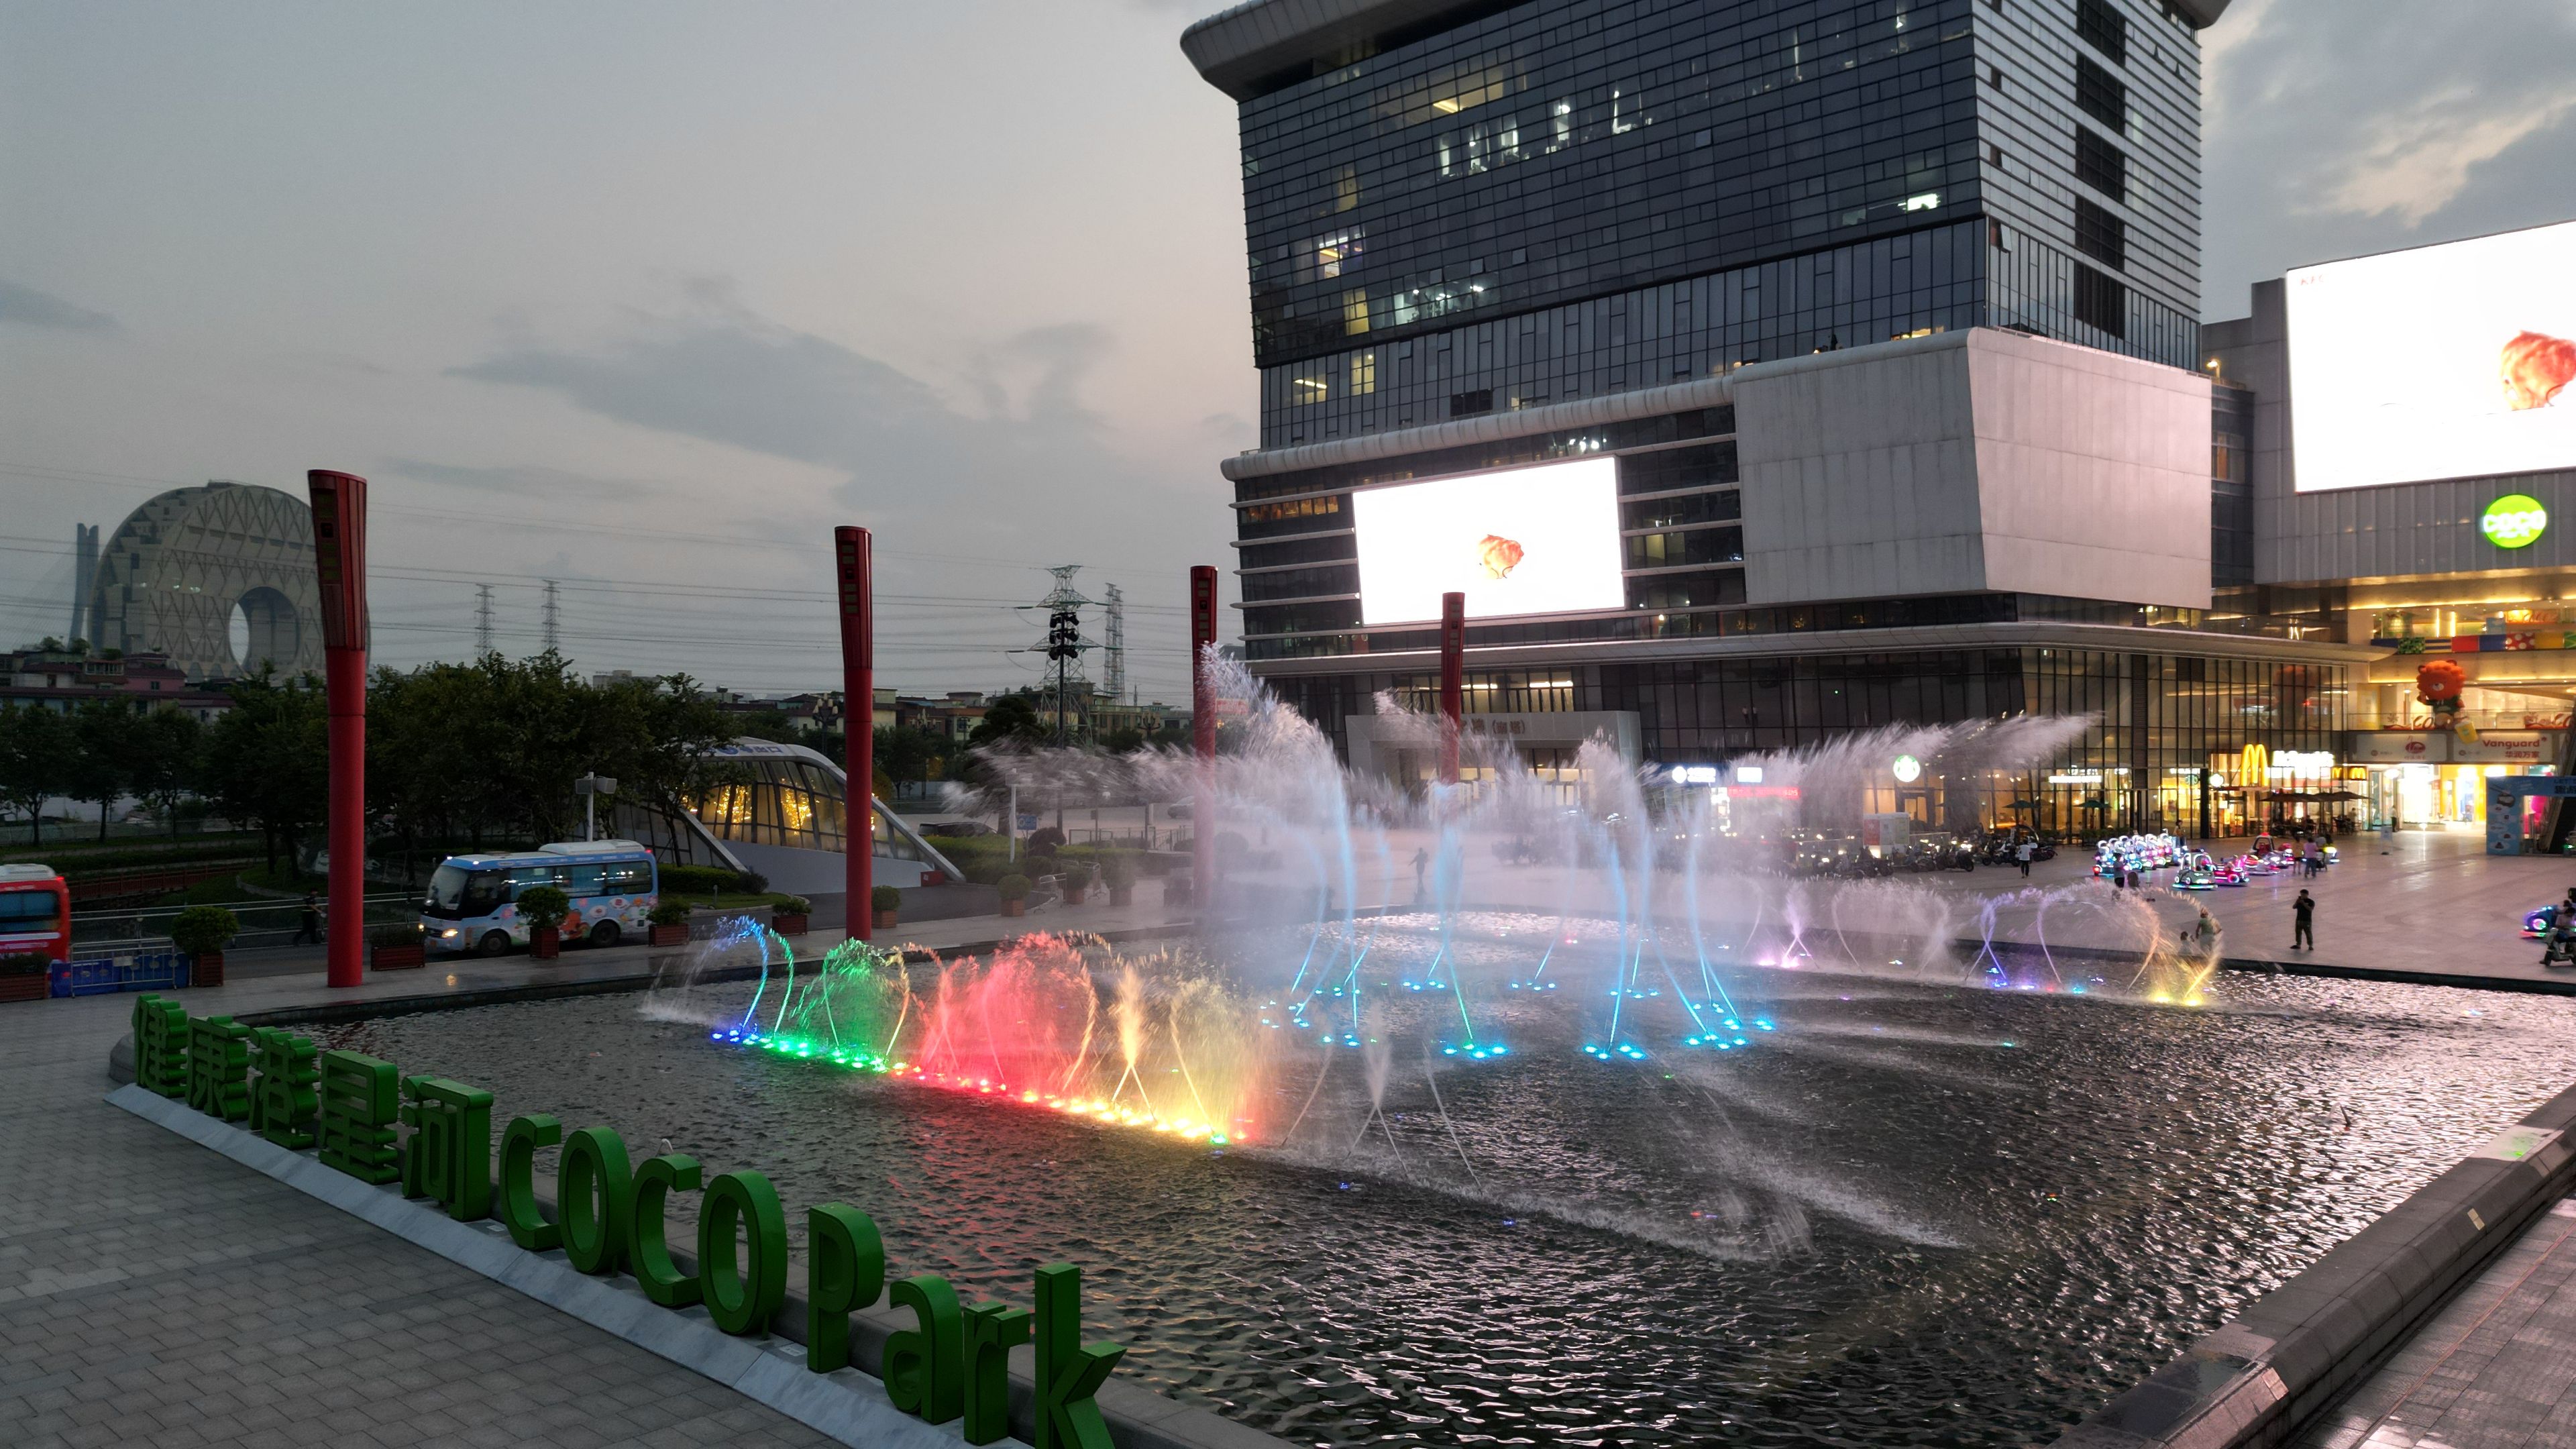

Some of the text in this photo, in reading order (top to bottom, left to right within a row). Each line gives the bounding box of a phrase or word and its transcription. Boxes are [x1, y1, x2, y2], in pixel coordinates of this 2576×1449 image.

[2483, 511, 2546, 533] COCO
[2483, 739, 2540, 749] Vanguard
[2505, 751, 2540, 759] 华润万家
[132, 994, 494, 1222] 健康港星河
[499, 1114, 1128, 1449] COCO Park
